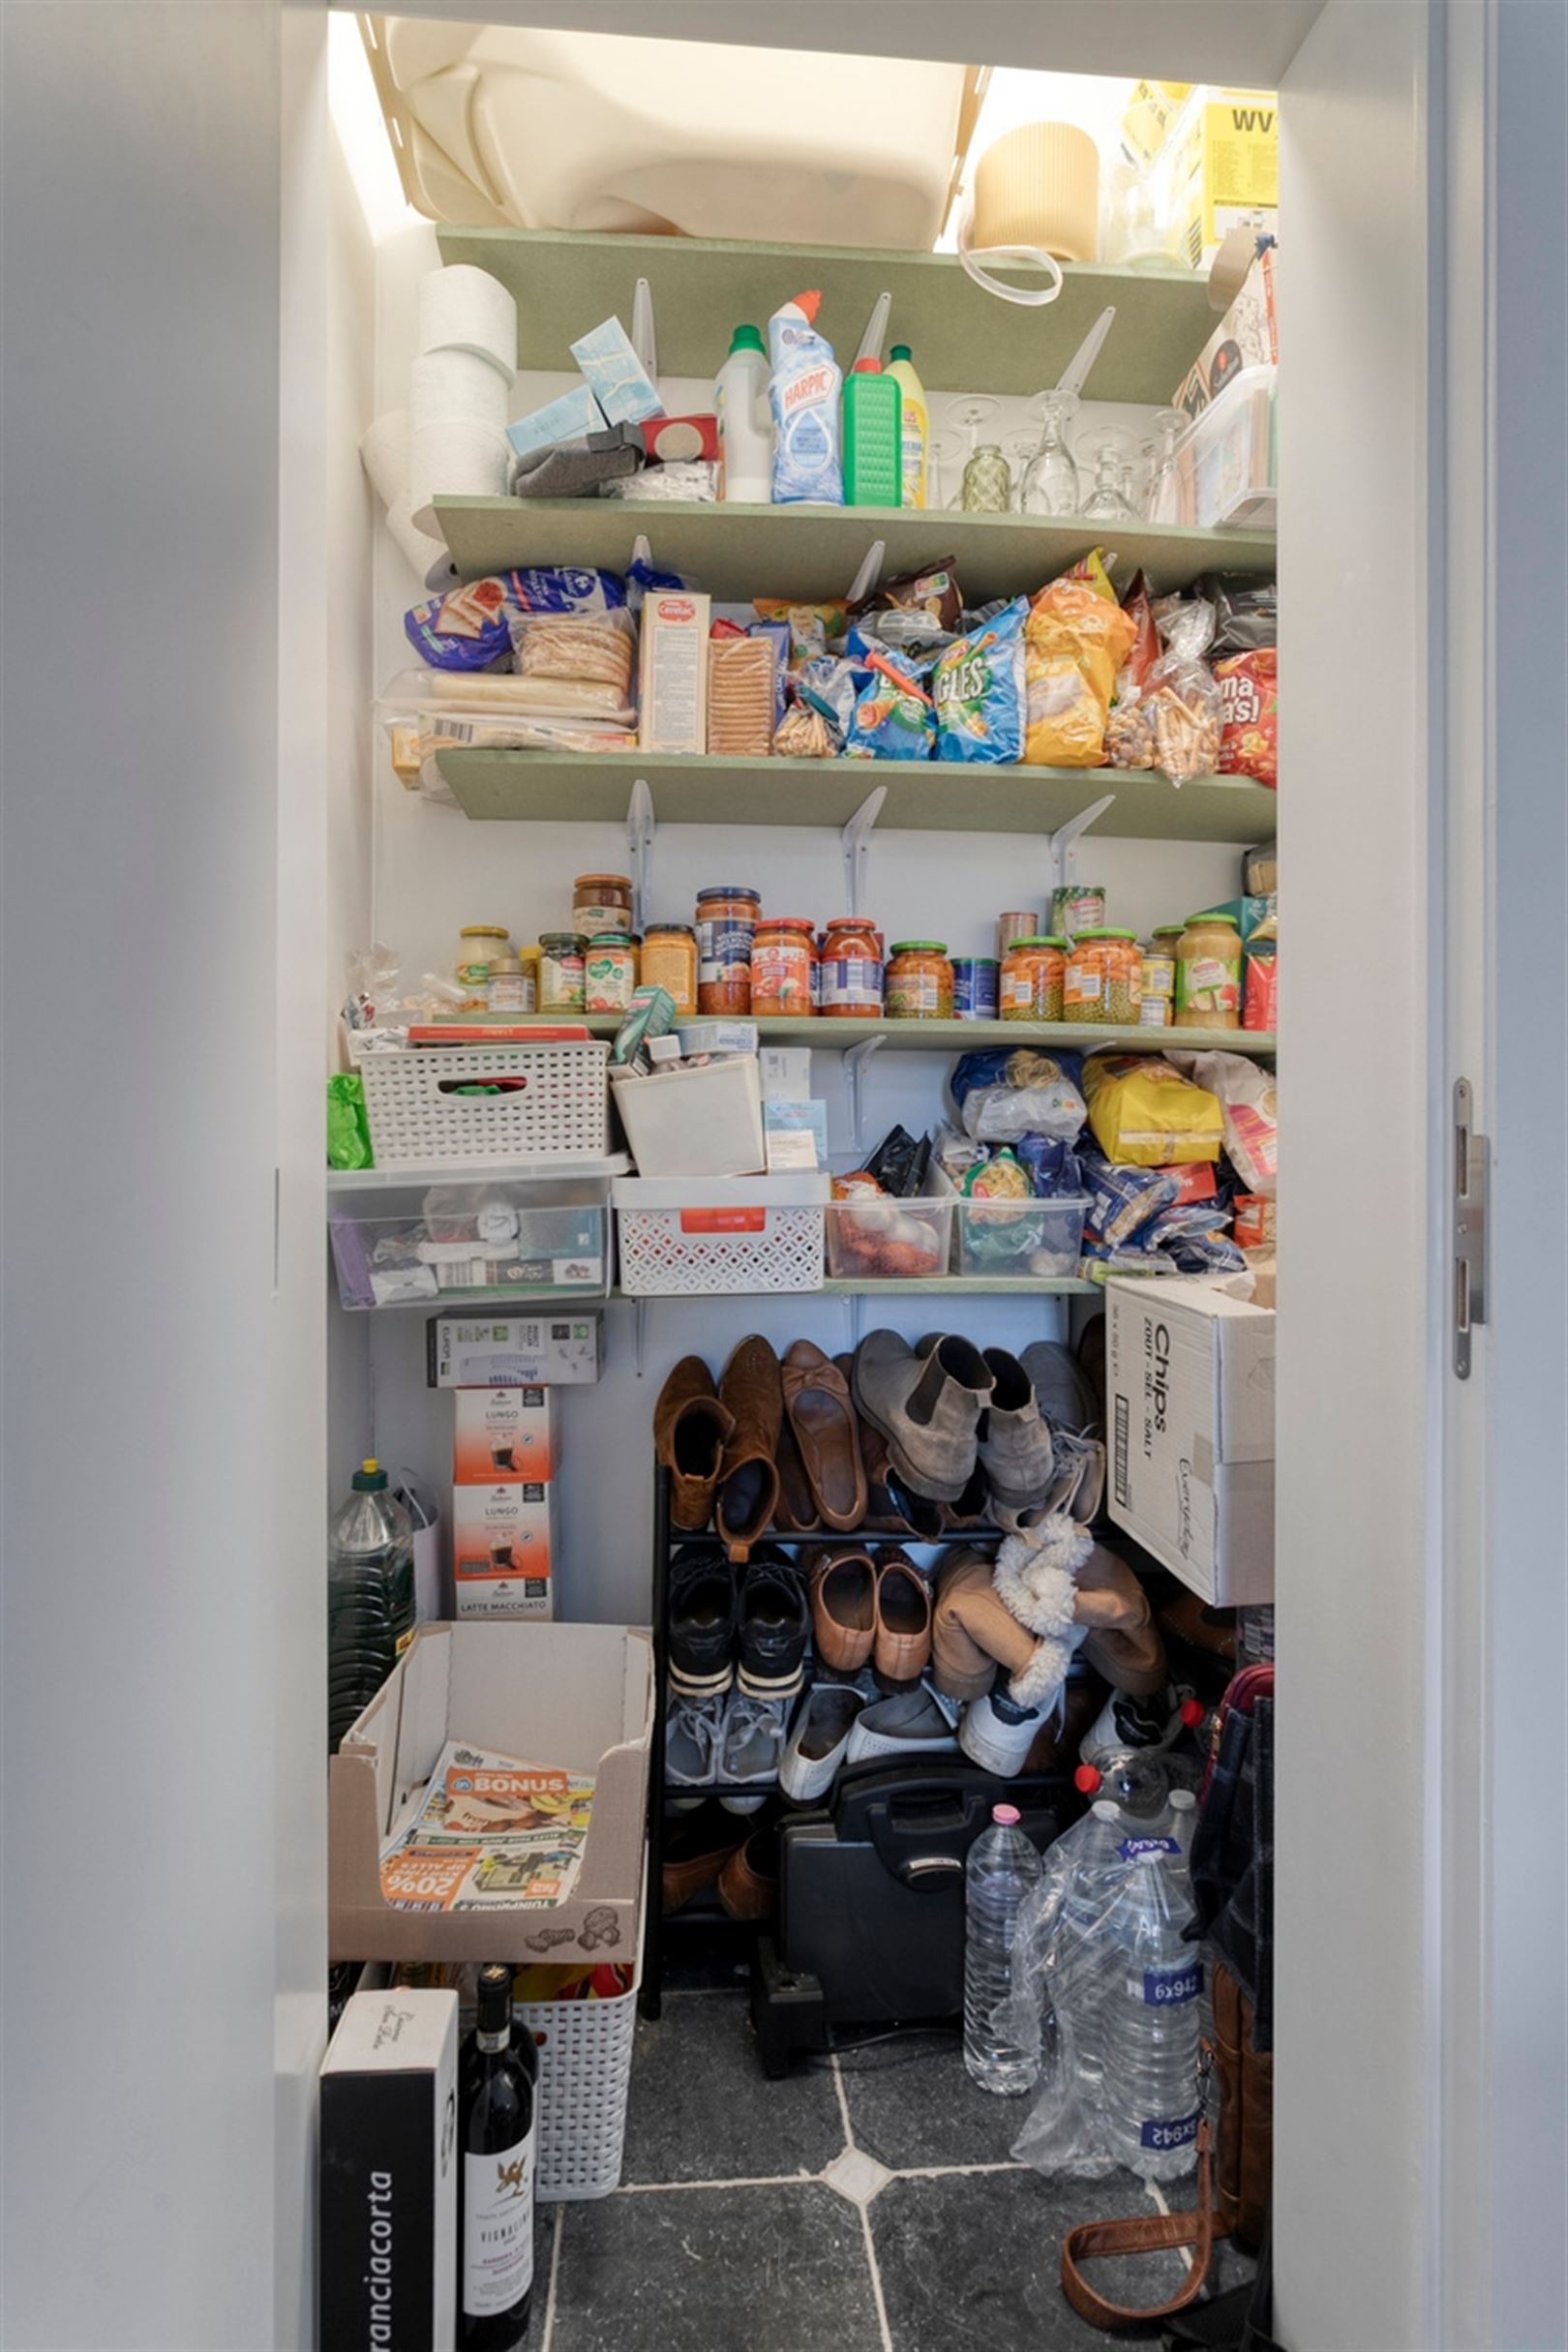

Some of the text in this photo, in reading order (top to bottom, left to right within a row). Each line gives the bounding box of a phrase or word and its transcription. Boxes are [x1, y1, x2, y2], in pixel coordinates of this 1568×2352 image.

[784, 371, 828, 408] HARPIC
[935, 657, 984, 704] GLES
[1220, 676, 1254, 698] ma
[1222, 695, 1260, 724] a's!
[1144, 1317, 1153, 1359] ZOUT
[1153, 1324, 1170, 1433] Chips
[485, 1410, 519, 1419] LUNGO
[1143, 1418, 1152, 1461] SALT
[485, 1507, 519, 1516] LUNGO
[461, 1600, 546, 1613] LATTE MACCHIATO
[474, 1778, 563, 1793] BONUS
[386, 1875, 455, 1896] 20%
[363, 2170, 392, 2352] ranciacorta
